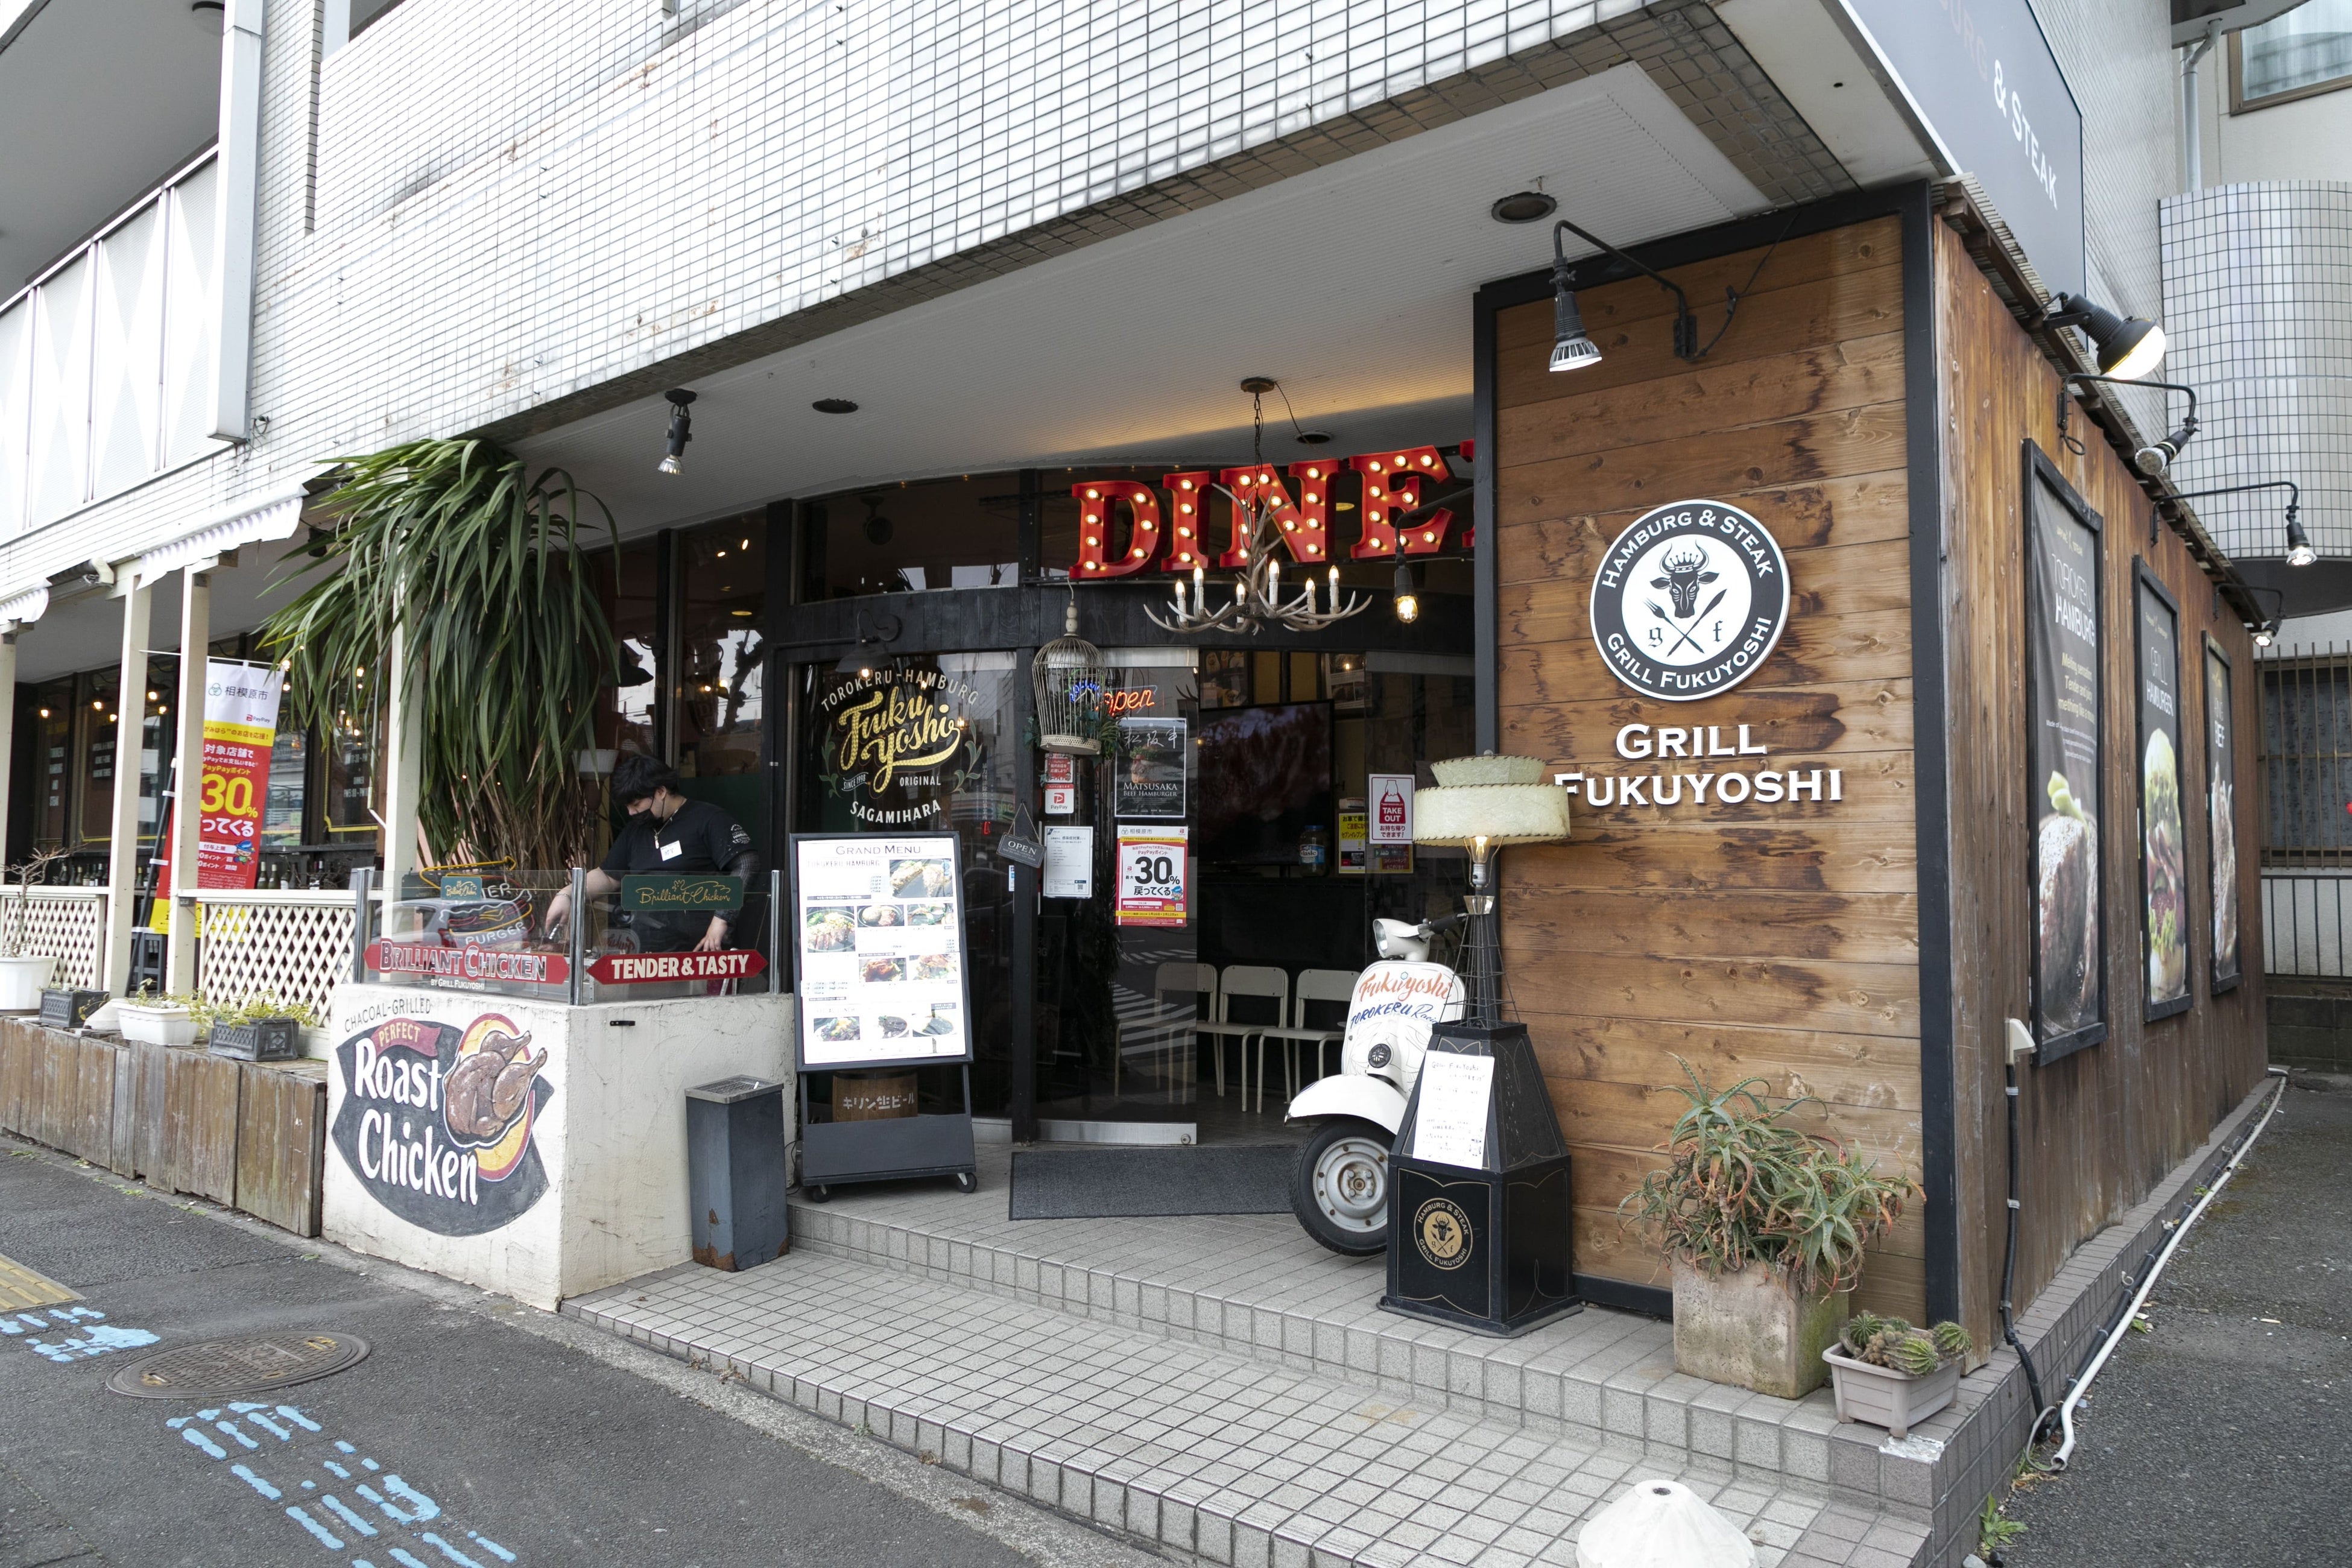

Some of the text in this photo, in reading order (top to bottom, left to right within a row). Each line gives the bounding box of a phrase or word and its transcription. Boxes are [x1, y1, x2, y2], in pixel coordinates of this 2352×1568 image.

[1994, 59, 2007, 118] &
[2011, 90, 2058, 210] STEAK
[1069, 439, 1474, 579] DINE
[1601, 509, 1774, 589] HAMBURG & STEAK
[2052, 554, 2092, 612] TOROKERU
[1713, 620, 1724, 642] f
[2055, 592, 2094, 647] HAMBURG
[1648, 626, 1663, 648] g
[1608, 618, 1772, 689] GRILL FUKUYOSHI
[225, 686, 268, 700] 相模原市
[838, 686, 928, 771] Fuku
[1124, 726, 1177, 750] 松阪牛
[1616, 723, 1768, 759] GRILL
[204, 743, 254, 758] 対象店舗で
[861, 704, 960, 793] yoshi
[843, 778, 855, 789] SINCE
[900, 776, 941, 786] ORIGINAL
[1124, 782, 1178, 791] MATSUSAKA
[1554, 769, 1844, 807] FUKUYOSHI
[201, 774, 258, 818] 30%
[850, 799, 941, 824] SAGAMIHARA
[836, 845, 921, 855] GRAND MENU
[1008, 840, 1037, 855] OPEN
[1134, 856, 1180, 885] 30%
[635, 880, 731, 905] Brilliant Chicken
[1134, 885, 1171, 896] 戻ってくる
[380, 941, 547, 982] BRILLIANT CHICKEN
[612, 954, 750, 980] TENDER & TASTY
[438, 978, 454, 987] GRILL
[454, 979, 485, 990] FUKUYOSHI
[1359, 971, 1453, 1002] Fukuyoshi
[345, 997, 431, 1032] CHACOAL-GRILLED
[1350, 1002, 1413, 1029] TOROKERU
[379, 1022, 421, 1048] PERFECT
[355, 1038, 441, 1111] Roast
[843, 1093, 915, 1110] キリン生ビール
[358, 1108, 478, 1206] Chicken
[1417, 1202, 1446, 1223] HAMBURG
[1453, 1209, 1469, 1235] STEAK
[1419, 1239, 1467, 1266] GRILL FUKUYOSHI
